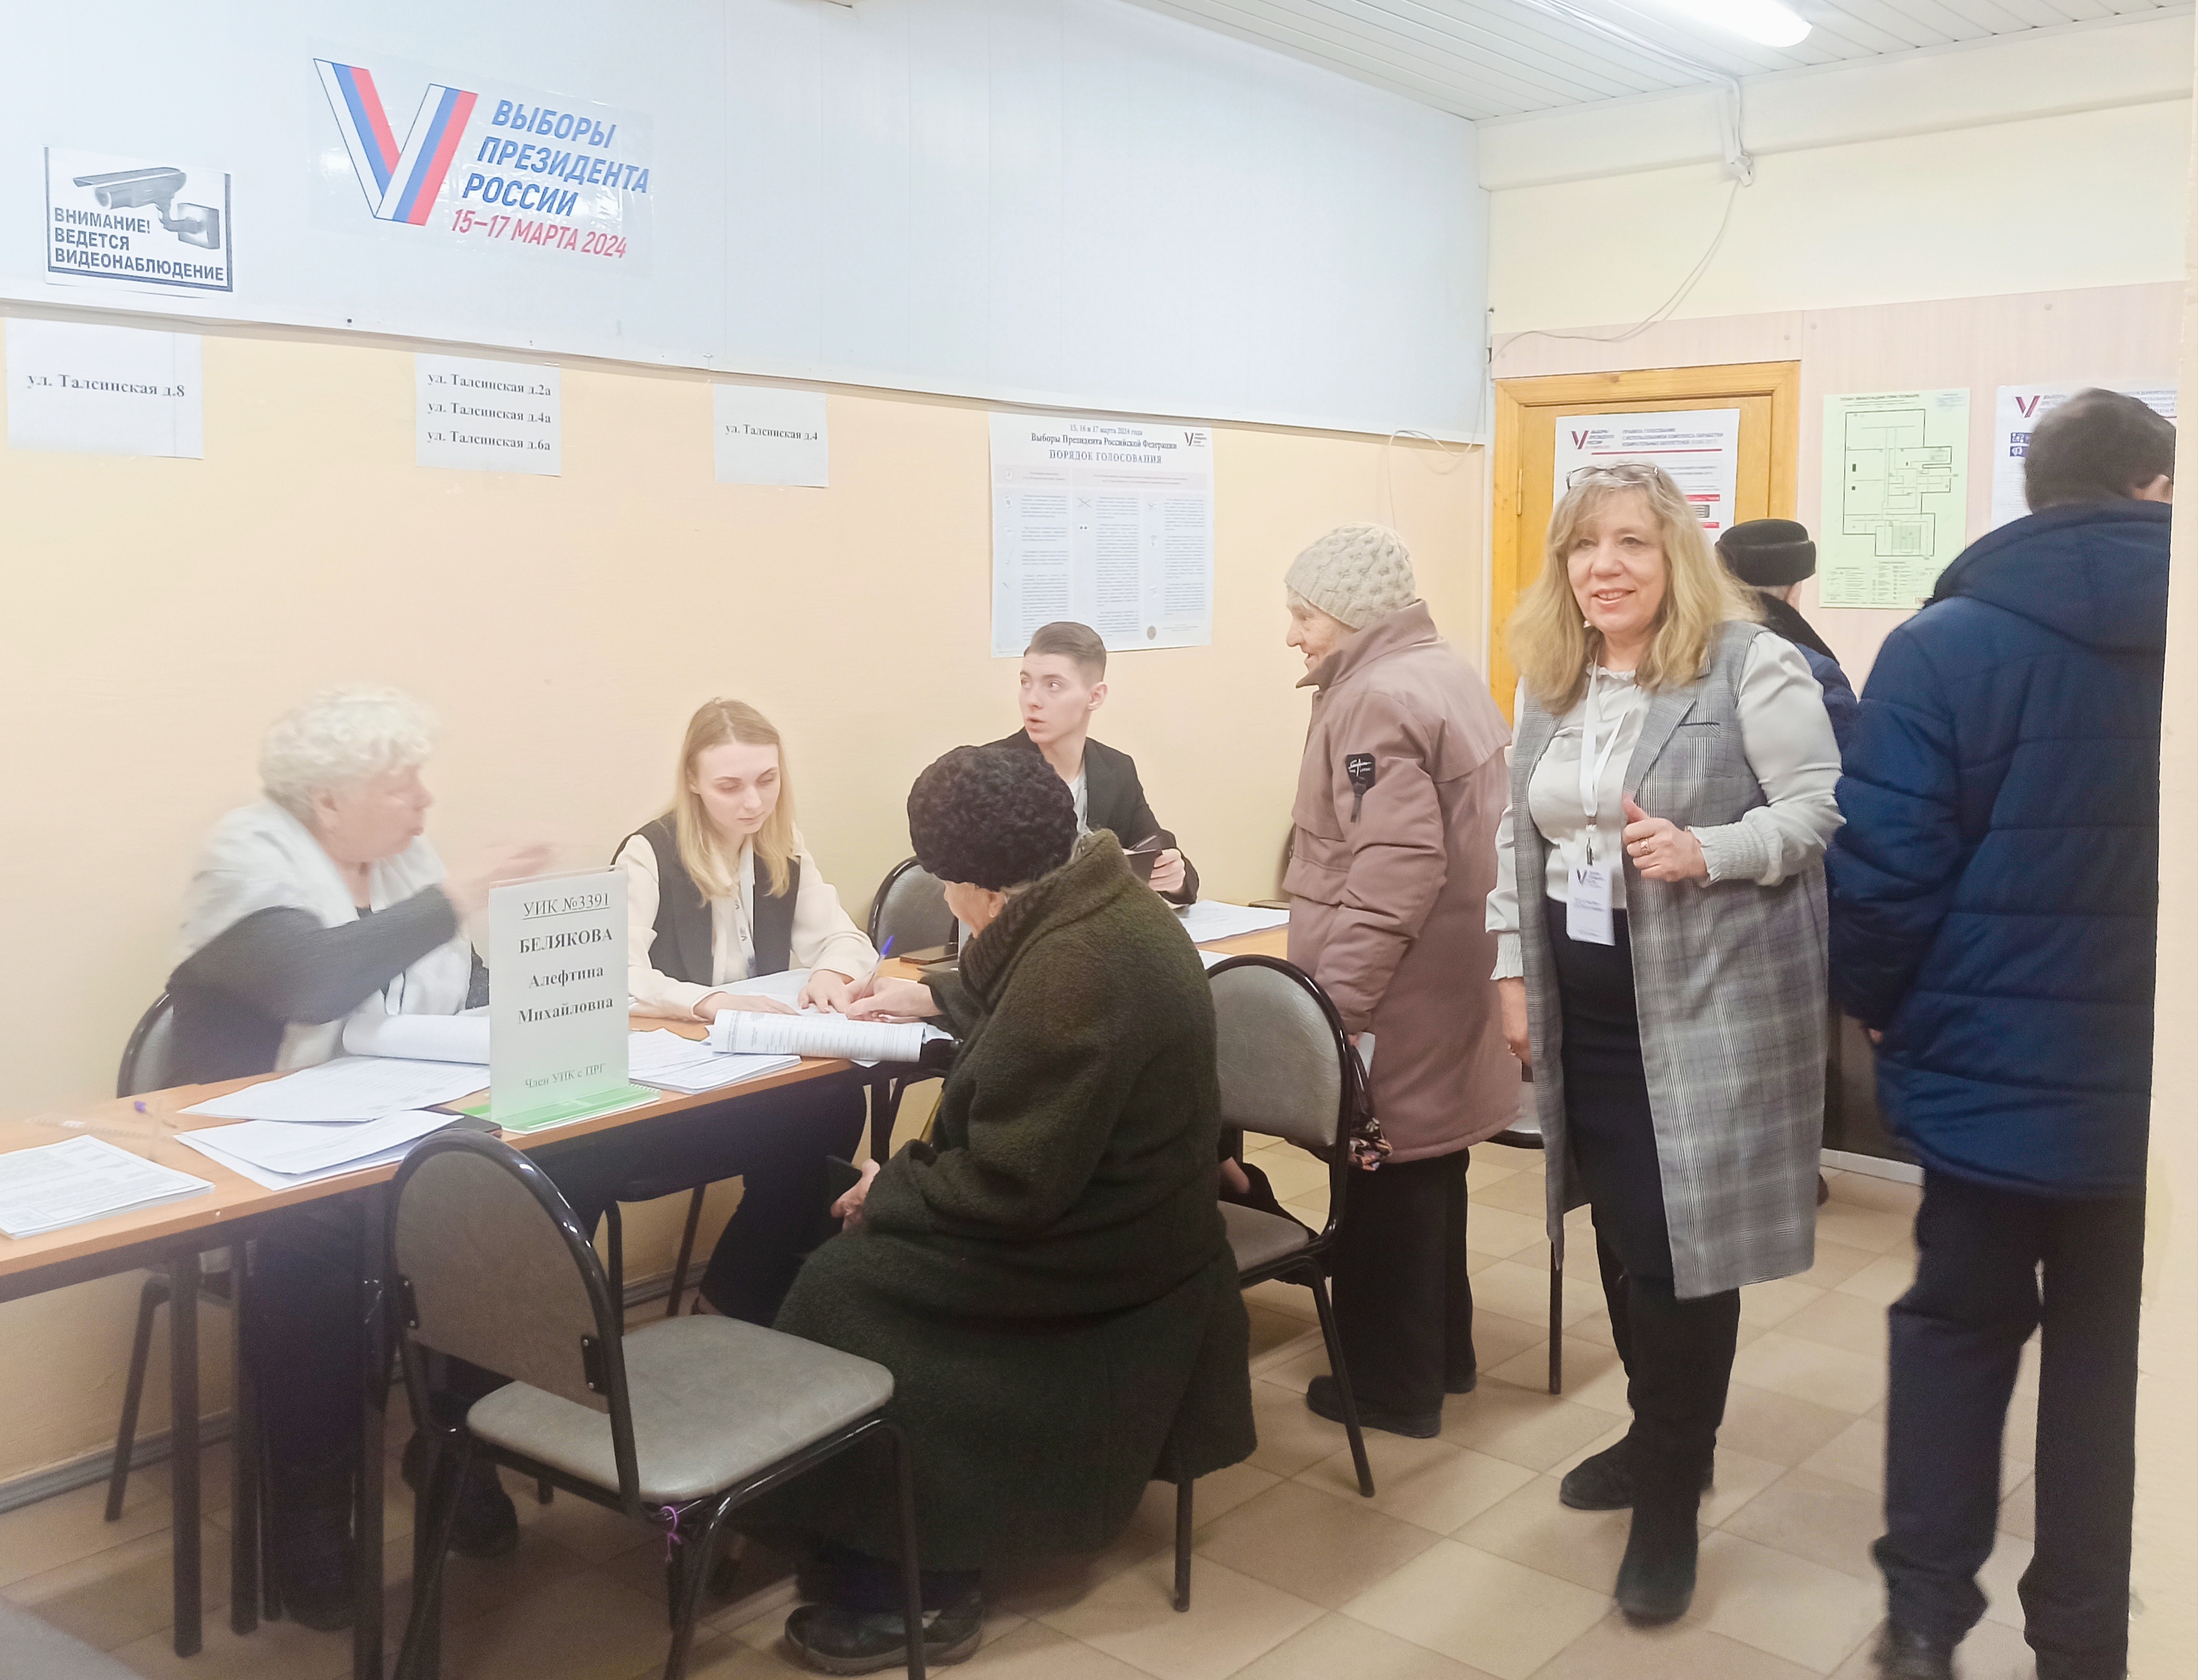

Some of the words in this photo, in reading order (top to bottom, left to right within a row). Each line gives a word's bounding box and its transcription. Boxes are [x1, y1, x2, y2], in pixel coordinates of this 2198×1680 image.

[491, 100, 617, 148] ВЫБОРЫ
[477, 136, 649, 193] ПРЕЗИДЕНТА
[462, 173, 579, 216] РОССИИ
[54, 207, 151, 233] ВНИМАНИЕ!
[55, 227, 129, 251] ВЕДЕТСЯ
[510, 219, 578, 250] МАРТА
[581, 232, 627, 258] 2024
[55, 248, 224, 281] ВИДЕОНАБЛЮДЕНИЕ
[27, 375, 52, 389] ул.
[58, 374, 158, 395] Талсинская
[162, 385, 185, 397] д.8
[428, 374, 447, 385] ул.
[451, 374, 524, 393] Талсинская
[527, 385, 551, 396] д.2а
[427, 403, 447, 414] ул.
[451, 402, 523, 421] Талсинская
[527, 412, 551, 424] д.4а
[427, 431, 446, 442] ул.
[450, 431, 523, 448] Талсинская
[526, 439, 551, 451] д.6а
[725, 425, 740, 435] ул.
[743, 424, 801, 439] Талсинская
[804, 431, 818, 440] д.4
[1031, 432, 1060, 444] Выборы
[1062, 434, 1102, 448] Президента
[1103, 437, 1141, 448] Российской
[1143, 439, 1177, 450] Федерации
[1049, 450, 1093, 461] ПОРЯДОК
[1096, 452, 1162, 464] ГОЛОСОВАНИЯ
[523, 898, 558, 917] УИК
[562, 893, 608, 911] №3391
[519, 927, 613, 954] БЕЛЯКОВА
[528, 967, 604, 989] Алефтина
[518, 998, 613, 1025] Михайловна
[525, 1077, 548, 1089] Член
[552, 1070, 575, 1084] УИК
[585, 1063, 605, 1076] ПРГ
